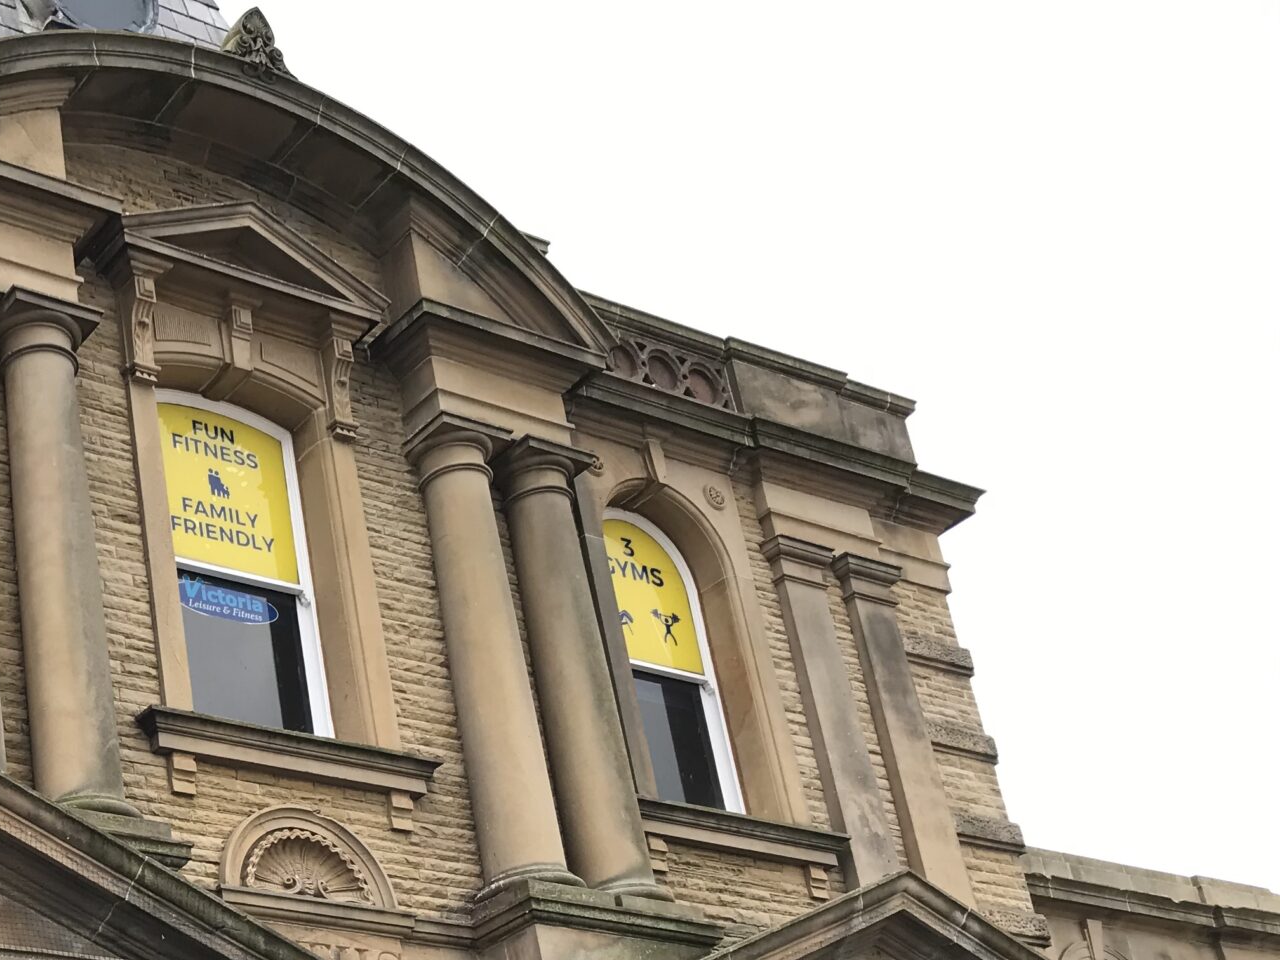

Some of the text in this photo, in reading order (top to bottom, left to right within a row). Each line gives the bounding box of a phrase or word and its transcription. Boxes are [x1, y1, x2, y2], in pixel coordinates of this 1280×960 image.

[192, 420, 234, 445] FUN
[171, 432, 259, 469] FITNESS
[182, 497, 258, 528] FAMILY
[171, 515, 274, 552] FRIENDLY
[620, 537, 635, 556] 3
[182, 574, 264, 613] Victoria
[189, 599, 263, 621] Leisure & Fitness
